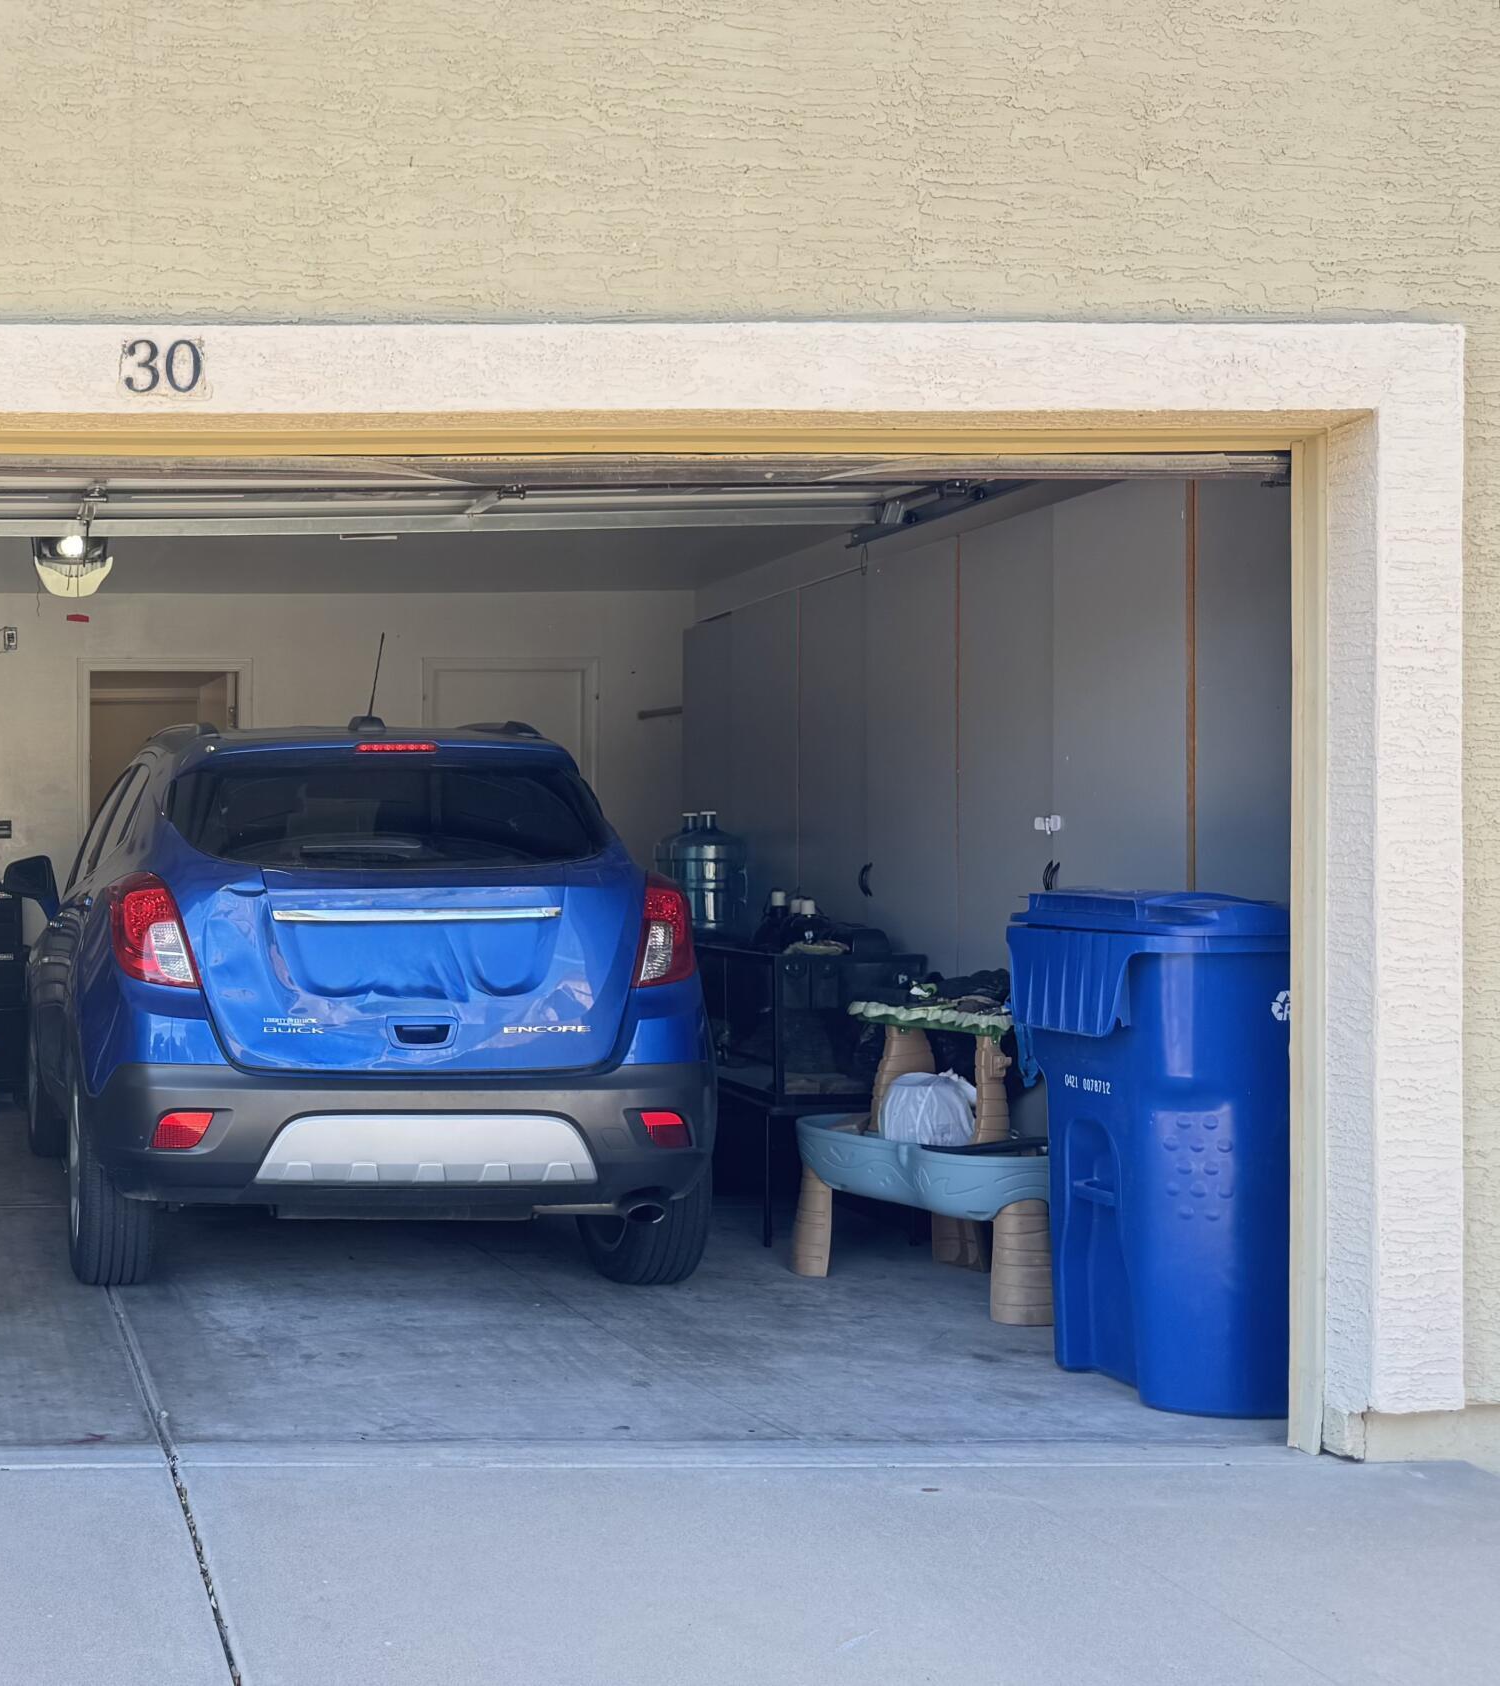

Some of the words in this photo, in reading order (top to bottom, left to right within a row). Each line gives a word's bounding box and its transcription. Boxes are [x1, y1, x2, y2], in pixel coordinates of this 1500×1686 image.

[125, 339, 201, 393] 30
[263, 1026, 325, 1034] BUICK
[503, 1025, 591, 1034] ENCORE
